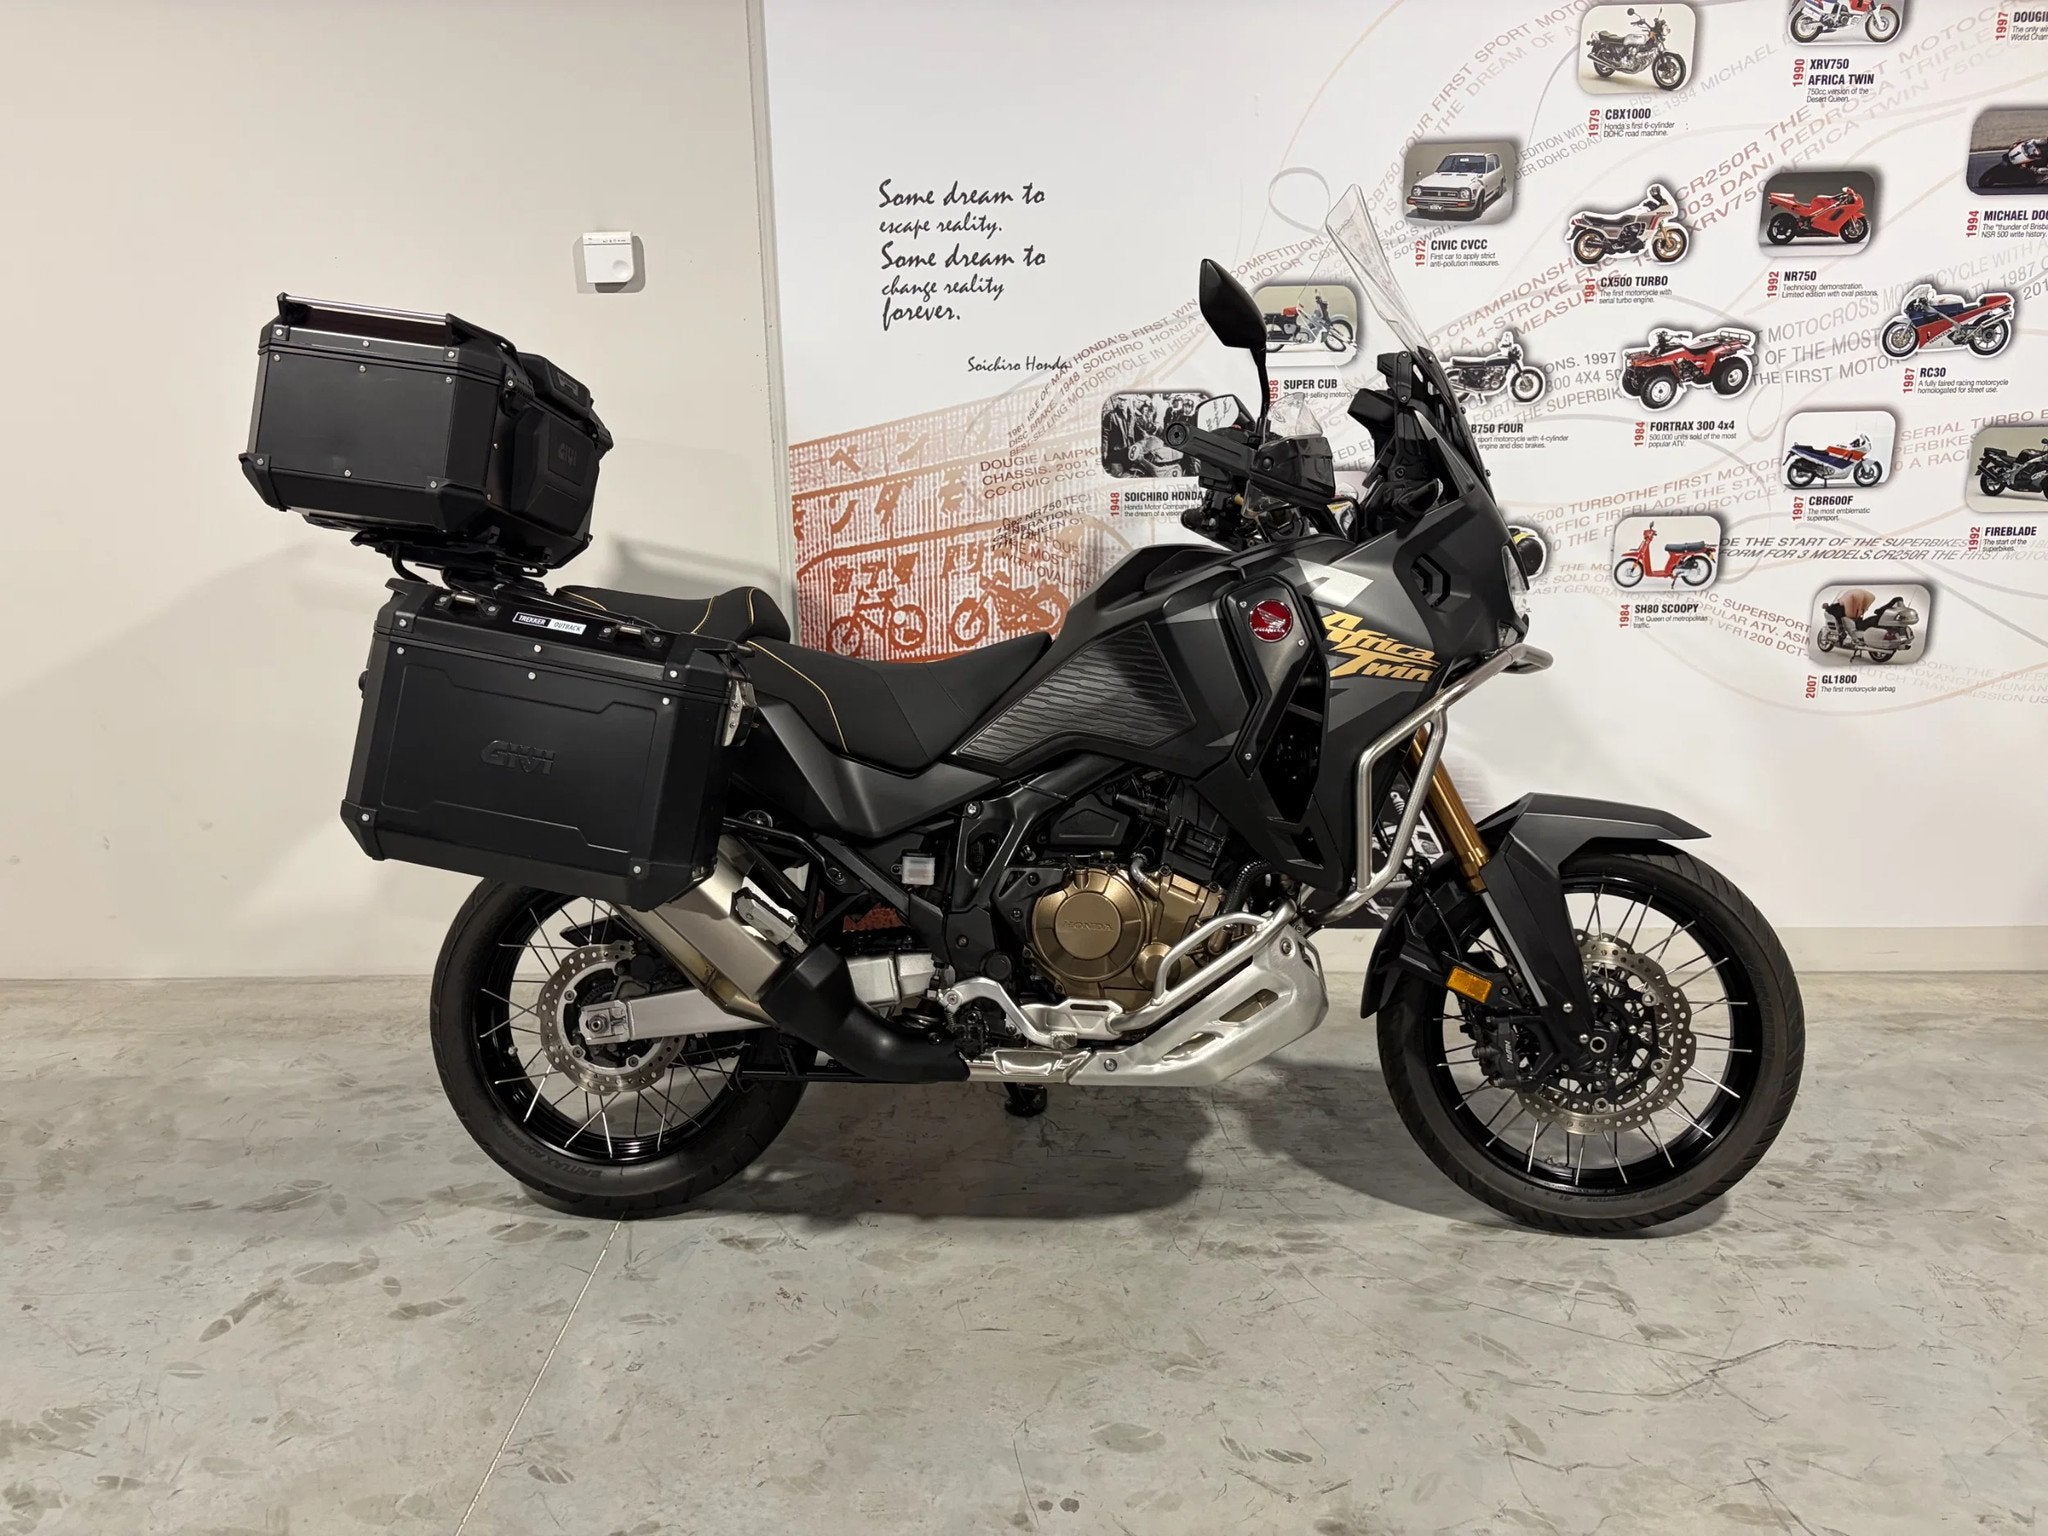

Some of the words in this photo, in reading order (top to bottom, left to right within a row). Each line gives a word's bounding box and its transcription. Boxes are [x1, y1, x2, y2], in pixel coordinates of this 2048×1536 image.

[1995, 12, 2009, 40] 1997
[2011, 33, 2030, 41] World
[1465, 46, 1528, 97] DREAM
[1530, 31, 1557, 51] OF
[1809, 58, 1850, 70] XRV750
[1899, 33, 1990, 83] TRIPLE
[1431, 62, 1474, 112] FIRST
[1474, 23, 1532, 63] SPORT
[1792, 59, 1805, 87] 1990
[1807, 74, 1845, 86] AFRICA
[1848, 73, 1875, 85] TWIN
[1806, 95, 1827, 103] Desert
[1827, 95, 1850, 103] Queen.
[1807, 88, 1827, 96] 750cc
[1605, 108, 1651, 120] CBX1000
[1588, 109, 1600, 137] 1979
[1604, 122, 1630, 130] Honda's
[1644, 121, 1675, 130] 6-cylinder
[1766, 105, 1812, 141] THE
[1603, 130, 1624, 138] DOHC
[1719, 155, 1776, 196] DANI
[1780, 82, 1897, 158] PEDROSA
[879, 178, 934, 208] Some
[943, 180, 1014, 206] dream
[1022, 182, 1045, 204] to
[1966, 210, 1979, 237] 1994
[1983, 210, 2029, 221] MICHAEL
[879, 219, 930, 239] escape
[936, 211, 1002, 239] reality.
[1981, 231, 1996, 239] NSR
[2025, 230, 2048, 239] history.
[1431, 239, 1458, 251] CIVIC
[1460, 239, 1488, 250] CVCC
[881, 241, 936, 270] Some
[945, 243, 1015, 268] dream
[1023, 244, 1046, 266] to
[1415, 240, 1426, 267] 1972
[1463, 253, 1480, 261] apply
[1250, 258, 1303, 285] MOTOR
[1430, 260, 1469, 268] anti-pollution
[1600, 276, 1632, 287] CX500
[1635, 275, 1668, 286] TURBO
[1784, 270, 1817, 281] NR750
[881, 275, 937, 302] change
[943, 273, 1004, 301] reality
[1584, 278, 1596, 304] 1981
[1766, 271, 1779, 298] 1992
[1783, 283, 1818, 292] Technology
[1818, 282, 1863, 291] demonstration.
[1625, 289, 1659, 297] motorcycle
[1633, 297, 1655, 305] engine.
[1781, 291, 1804, 299] Limited
[1805, 290, 1826, 298] edition
[1854, 290, 1879, 298] pistons.
[882, 297, 960, 331] forever.
[1768, 298, 1881, 344] MOTOCROSS
[1073, 333, 1129, 364] HONDA'S
[1131, 317, 1170, 338] FIRST
[1172, 298, 1198, 319] WIN
[1765, 346, 1794, 365] OF
[1799, 340, 1828, 361] THE
[1832, 328, 1880, 354] MOST
[967, 356, 1021, 372] Soichiro
[1025, 355, 1068, 371] Honda
[1060, 372, 1081, 397] 1948
[1084, 341, 1144, 373] SOICHIRO
[1149, 316, 1197, 345] HONDA
[1585, 351, 1616, 366] 1997
[1068, 355, 1150, 405] MOTORCYCLE
[1785, 366, 1833, 385] FIRST
[1919, 367, 1946, 378] RC30
[1283, 379, 1315, 390] SUPER
[1317, 379, 1338, 389] CUB
[1903, 368, 1916, 394] 1987
[1938, 379, 1955, 387] faired
[1956, 379, 1975, 388] racing
[1975, 379, 2009, 387] motorcycle
[1917, 387, 1957, 395] homologated
[1469, 423, 1495, 434] B750
[1498, 423, 1524, 434] FOUR
[1634, 421, 1646, 447] 1984
[1650, 420, 1694, 432] FORTRAX
[1696, 420, 1715, 431] 300
[1717, 420, 1735, 430] 4x4
[1900, 421, 1965, 442] SERIAL
[1970, 410, 2035, 430] TURBO
[1493, 435, 1525, 443] motorcycle
[1540, 434, 1569, 443] 4-cylinder
[1648, 441, 1671, 449] popular
[1478, 443, 1498, 451] engine
[980, 454, 1038, 472] DOUGIE
[983, 465, 1051, 486] CHASSIS.
[1056, 460, 1089, 472] 2001
[1055, 469, 1097, 483] CVCC
[1124, 492, 1169, 502] SOICHIRO
[1171, 491, 1204, 501] HONDA
[1693, 486, 1727, 503] THE
[1808, 495, 1853, 506] CBR600F
[1025, 500, 1062, 520] NR750
[1110, 492, 1120, 517] 1948
[1124, 503, 1143, 511] Honda
[1144, 503, 1162, 511] Motor
[1162, 503, 1189, 511] Company
[1792, 496, 1804, 521] 1987
[1836, 507, 1870, 515] emblematic
[1806, 515, 1840, 523] supersport.
[1968, 526, 1980, 551] 1992
[1984, 526, 2037, 536] FIREBLADE
[1745, 537, 1778, 547] THE
[1779, 537, 1828, 547] START
[1829, 537, 1852, 547] OF
[1853, 537, 1882, 547] THE
[1882, 537, 1967, 548] SUPERBIKES
[1982, 545, 2016, 553] superbikes.
[1931, 549, 1959, 560] THE
[1619, 604, 1630, 628] 1984
[1634, 604, 1659, 614] SH80
[1661, 603, 1700, 613] SCOOPY
[1723, 598, 1812, 633] SUPERSPORT
[518, 615, 546, 626] TREKKER
[553, 622, 581, 632] OUTBACK
[1645, 615, 1664, 623] Queen
[1672, 615, 1708, 623] metropolitan
[1718, 620, 1774, 647] VFR1200
[1750, 620, 1779, 636] ATV.
[1321, 610, 1441, 667] Africa
[1328, 650, 1434, 682] Twin
[1805, 675, 1817, 699] 2007
[1821, 674, 1857, 684] GL1800
[1844, 685, 1877, 693] motorcycle
[1877, 685, 1896, 693] airbag
[481, 740, 556, 776] GIVI
